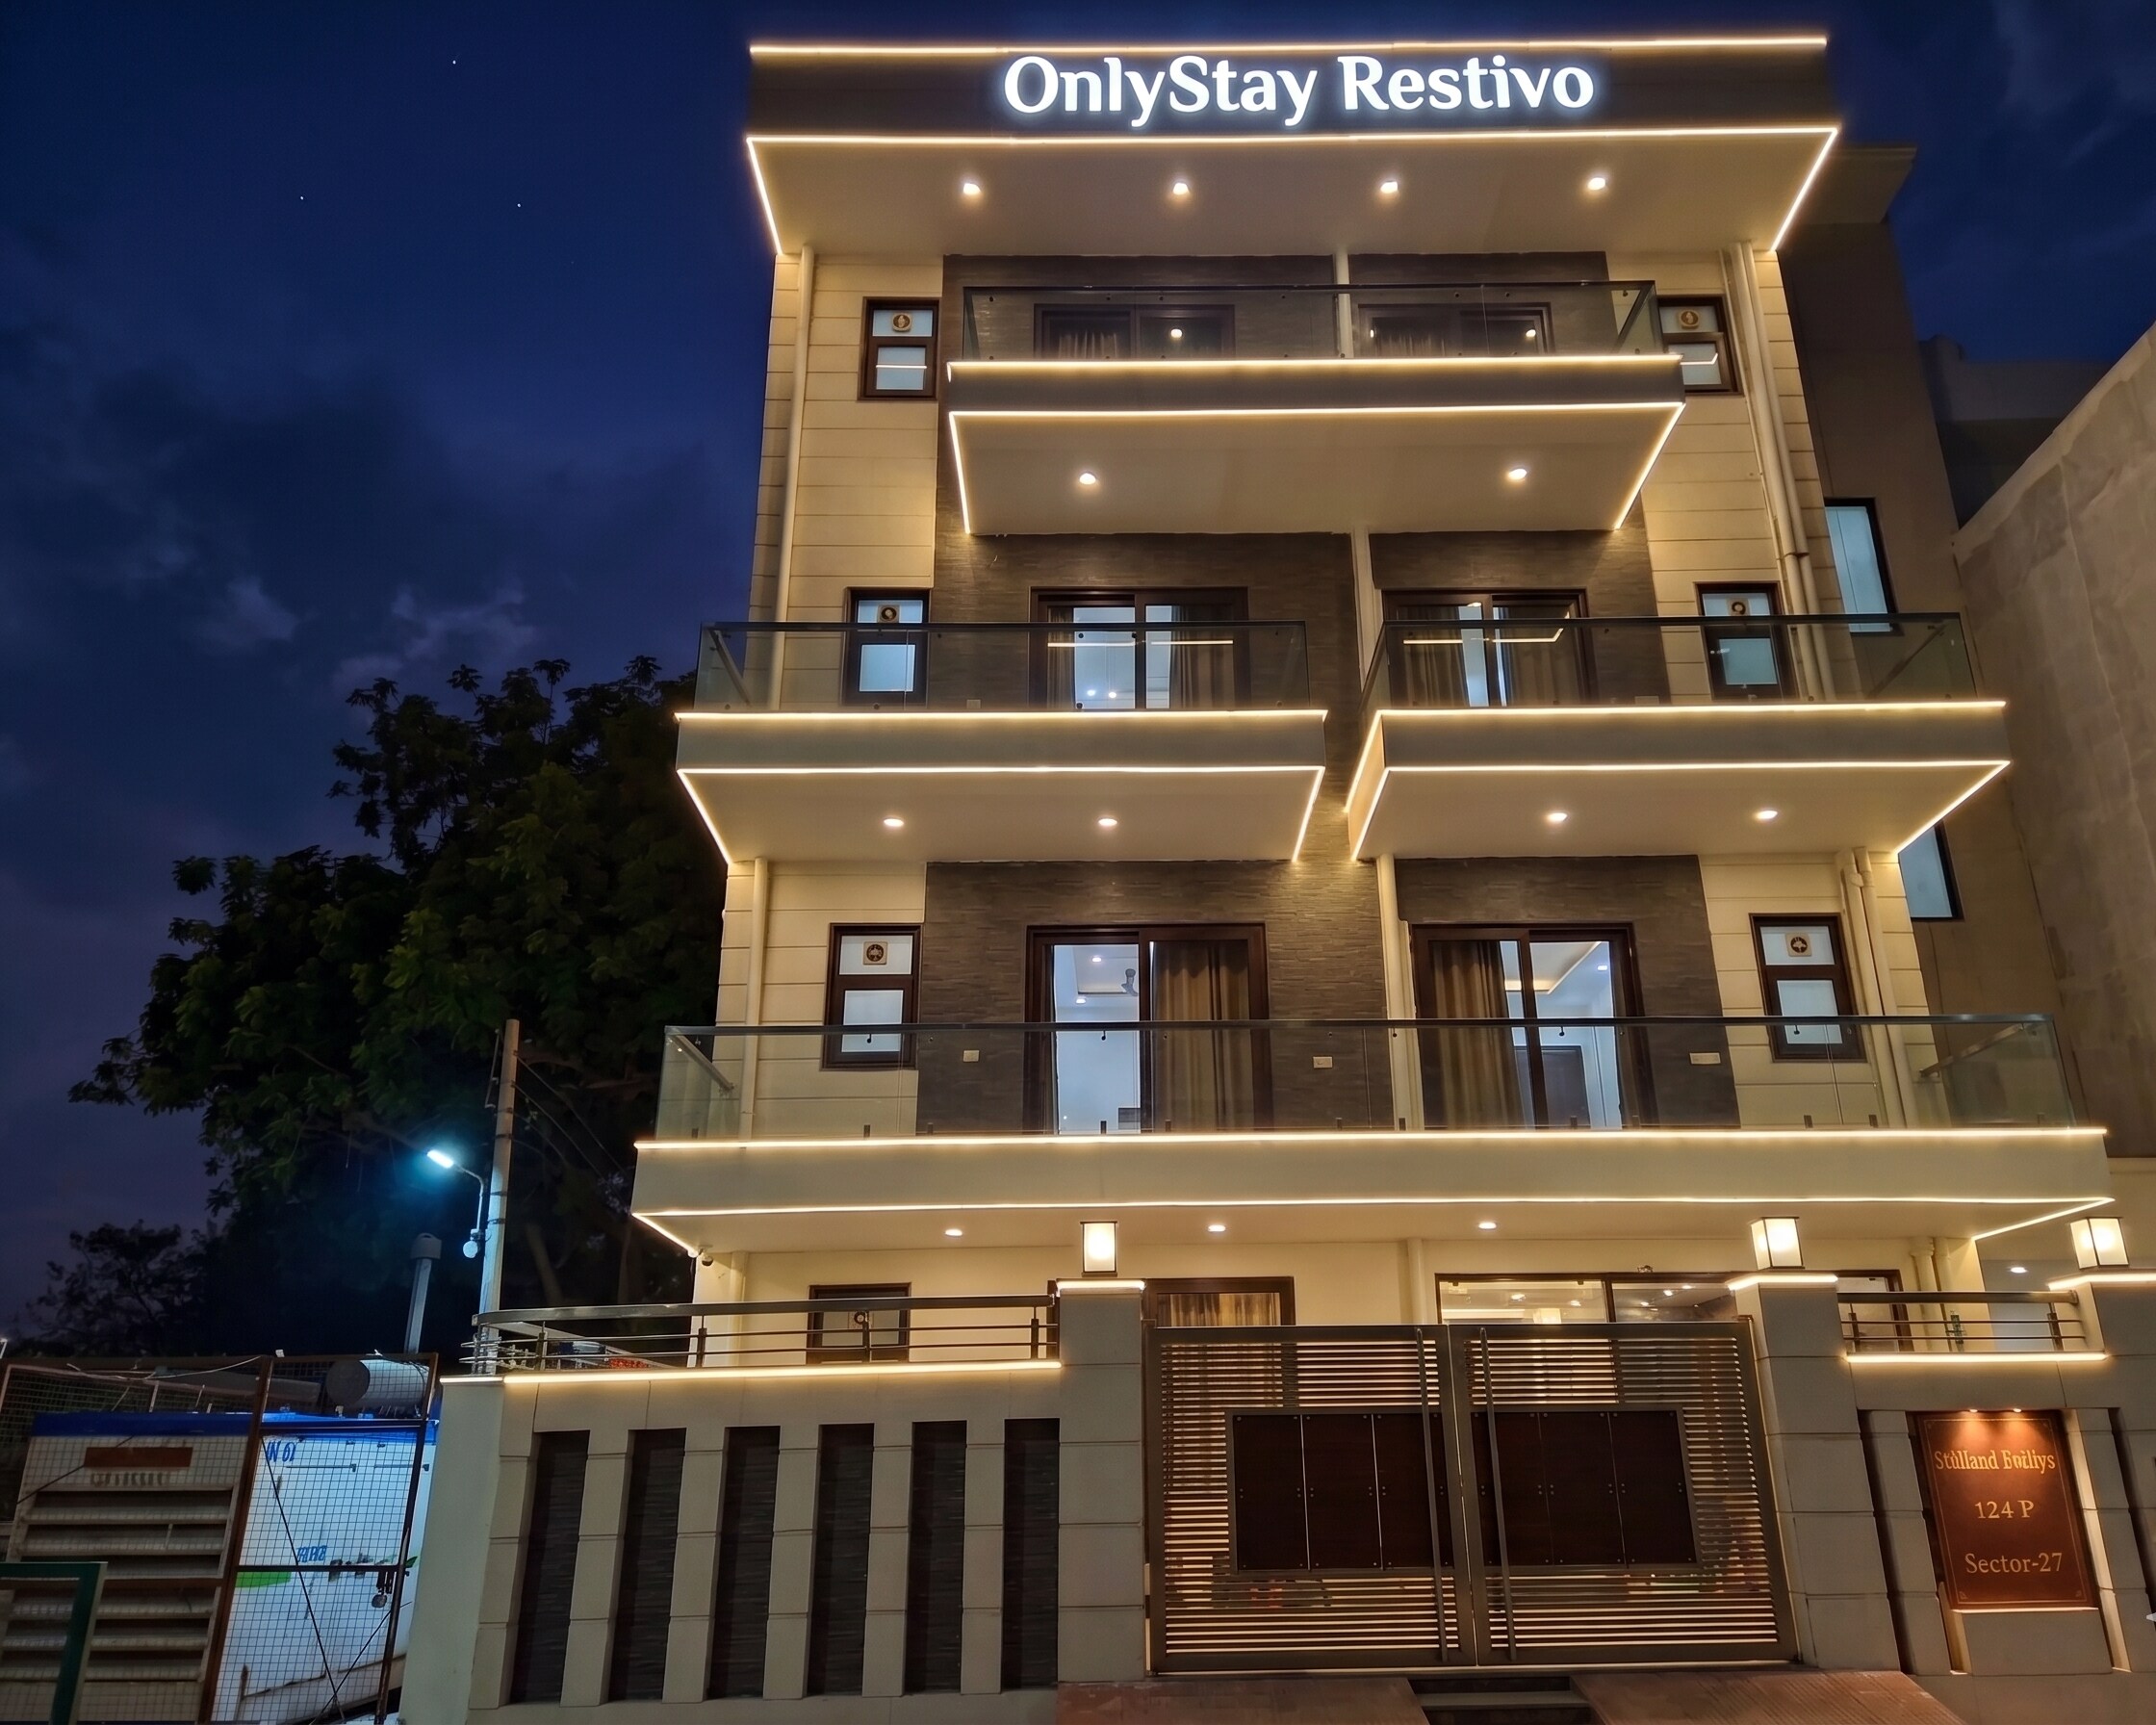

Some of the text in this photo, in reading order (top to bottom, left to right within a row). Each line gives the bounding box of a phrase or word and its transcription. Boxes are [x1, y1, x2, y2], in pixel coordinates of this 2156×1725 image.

[1004, 55, 1594, 127] OnlyStay Restivo
[1974, 1499, 2035, 1519] 124 P
[1964, 1552, 2063, 1574] Sector-27
